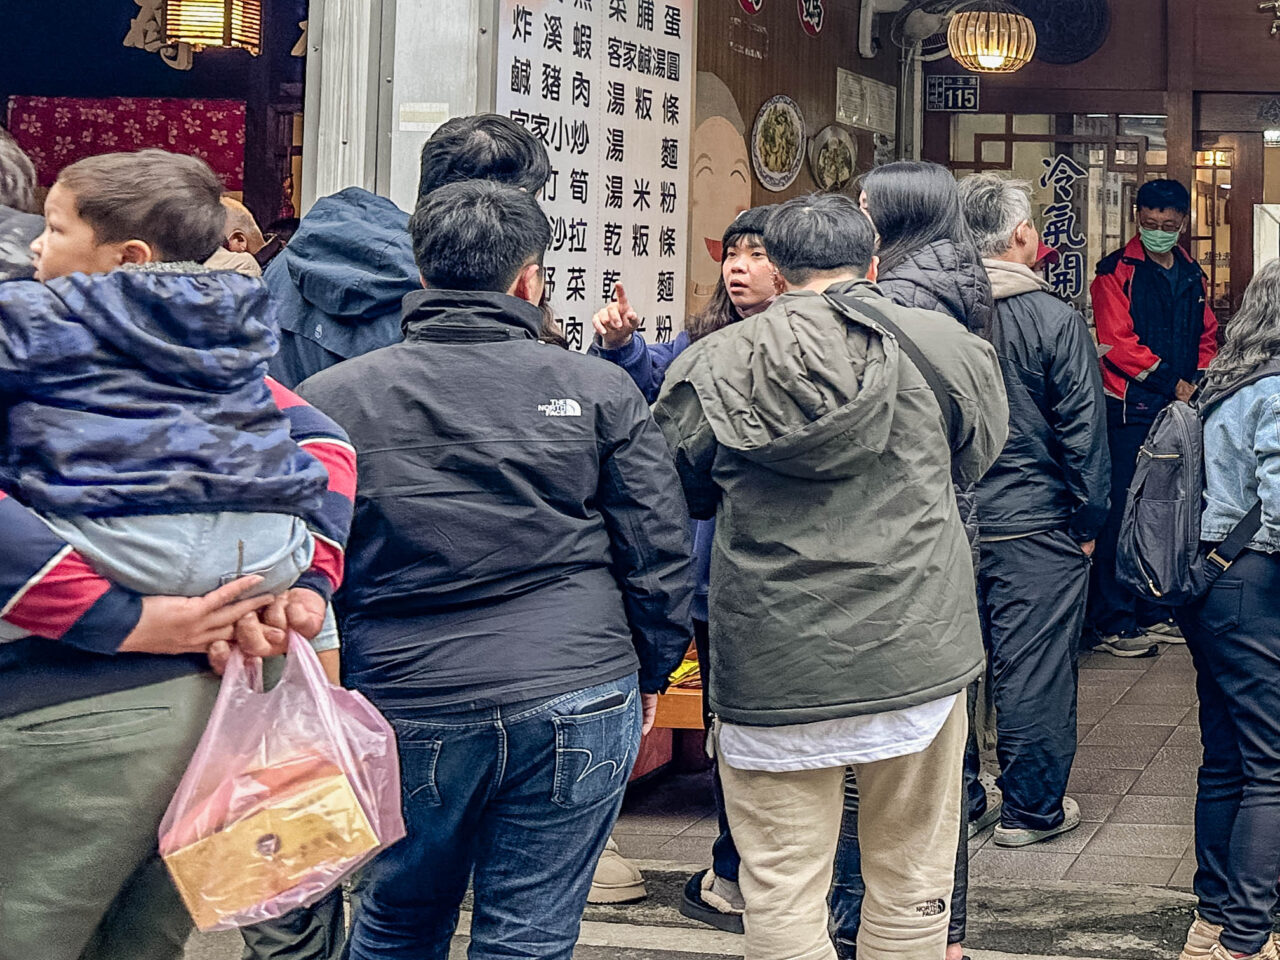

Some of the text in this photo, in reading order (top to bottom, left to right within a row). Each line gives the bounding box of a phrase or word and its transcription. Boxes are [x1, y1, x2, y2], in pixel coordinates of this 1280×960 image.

[512, 4, 592, 60] 炸溪蝦
[510, 55, 590, 108] 鹹豬肉
[607, 36, 680, 82] 客家鹹湯圓
[606, 80, 679, 126] 湯粄條
[946, 89, 975, 107] 115
[604, 175, 677, 214] 湯米粉
[603, 221, 676, 258] 乾粄條
[1040, 154, 1088, 302] 冷氣開
